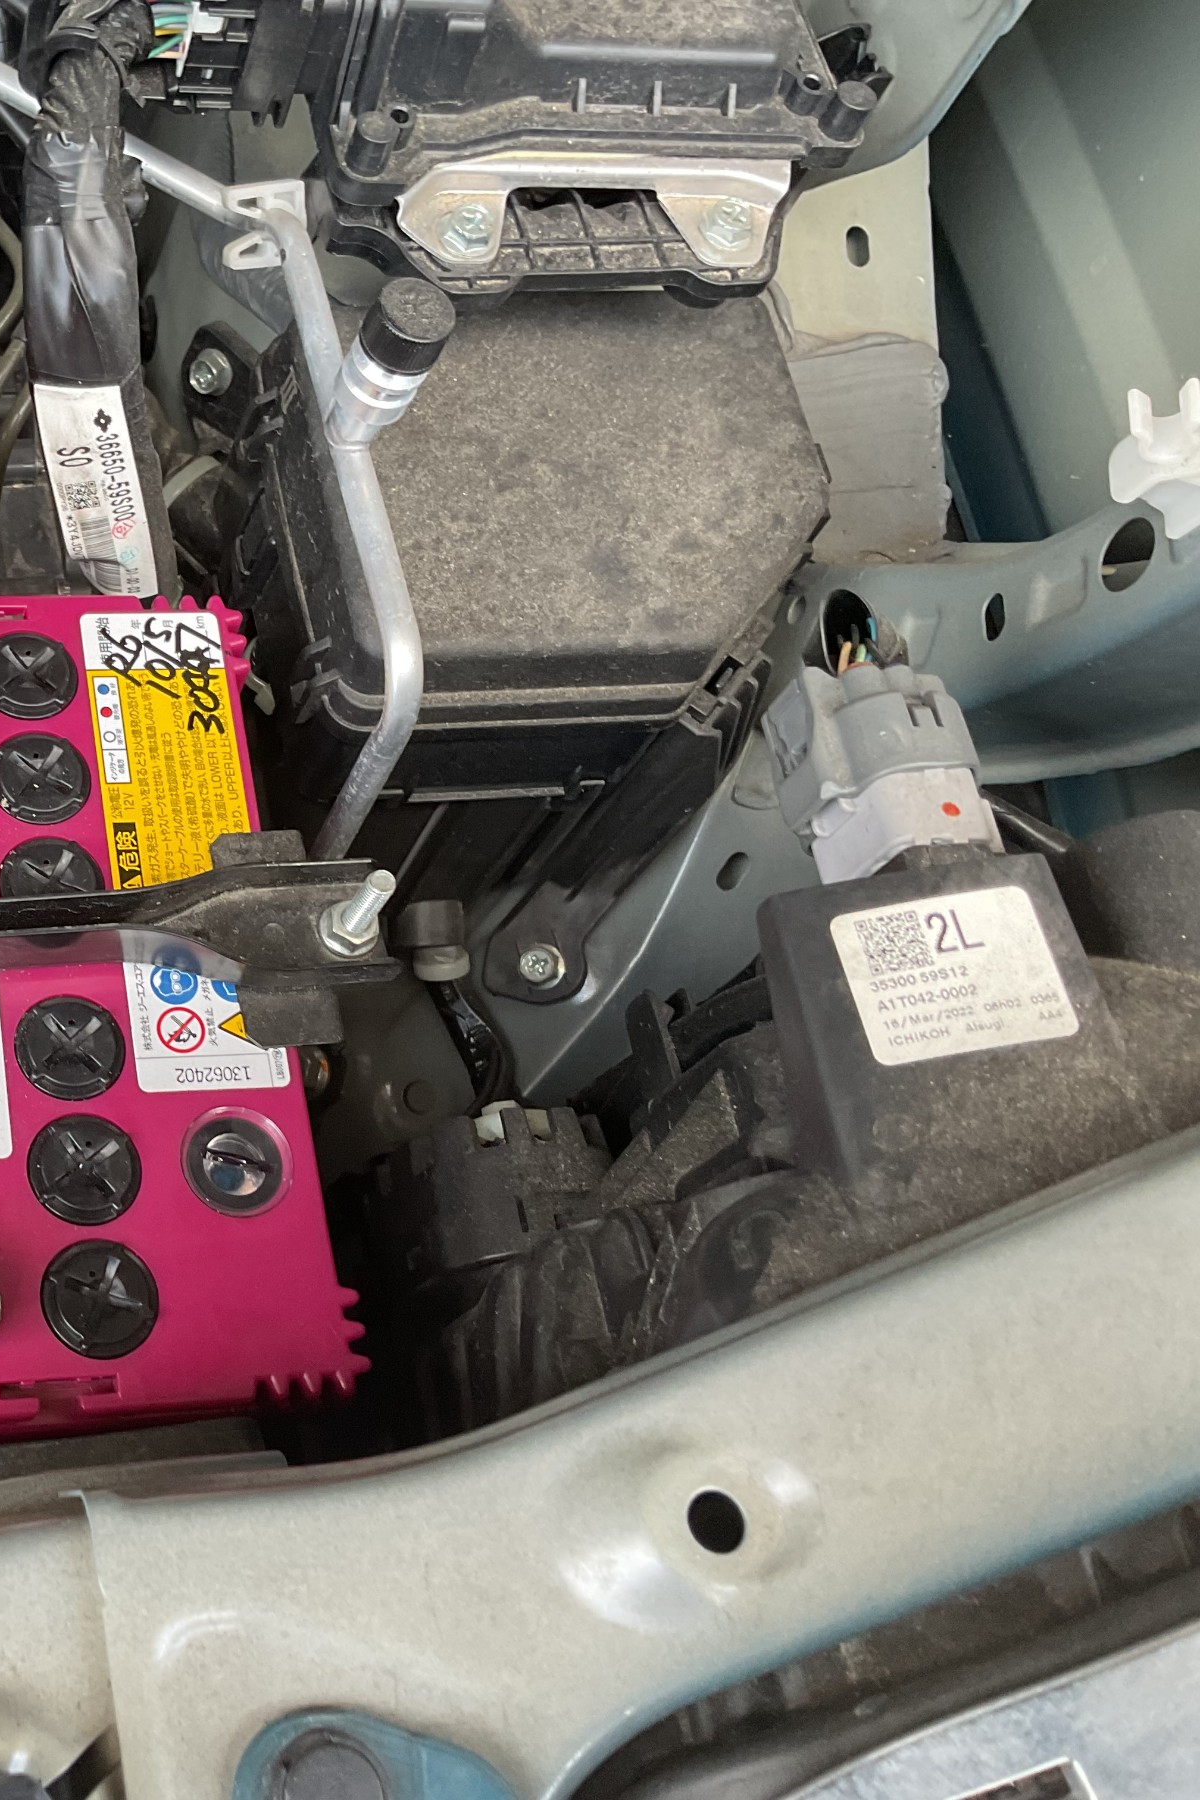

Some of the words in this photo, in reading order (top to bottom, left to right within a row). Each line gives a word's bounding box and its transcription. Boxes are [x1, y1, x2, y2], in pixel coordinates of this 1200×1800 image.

[96, 433, 136, 522] 36650-59S00
[131, 619, 141, 629] 年
[163, 619, 174, 629] 月
[195, 616, 205, 629] km
[208, 752, 223, 789] LOWER
[122, 792, 136, 811] 12V
[119, 830, 140, 872] 危険
[925, 908, 986, 956] 2L
[869, 973, 917, 994] 35300
[922, 965, 970, 985] 59S12
[877, 984, 978, 1013] A1T042-0002
[140, 1015, 152, 1051] 株式会社
[205, 1007, 218, 1047] 火気禁止
[887, 1026, 950, 1048] ICHIKOH
[175, 1065, 252, 1083] 13062402
